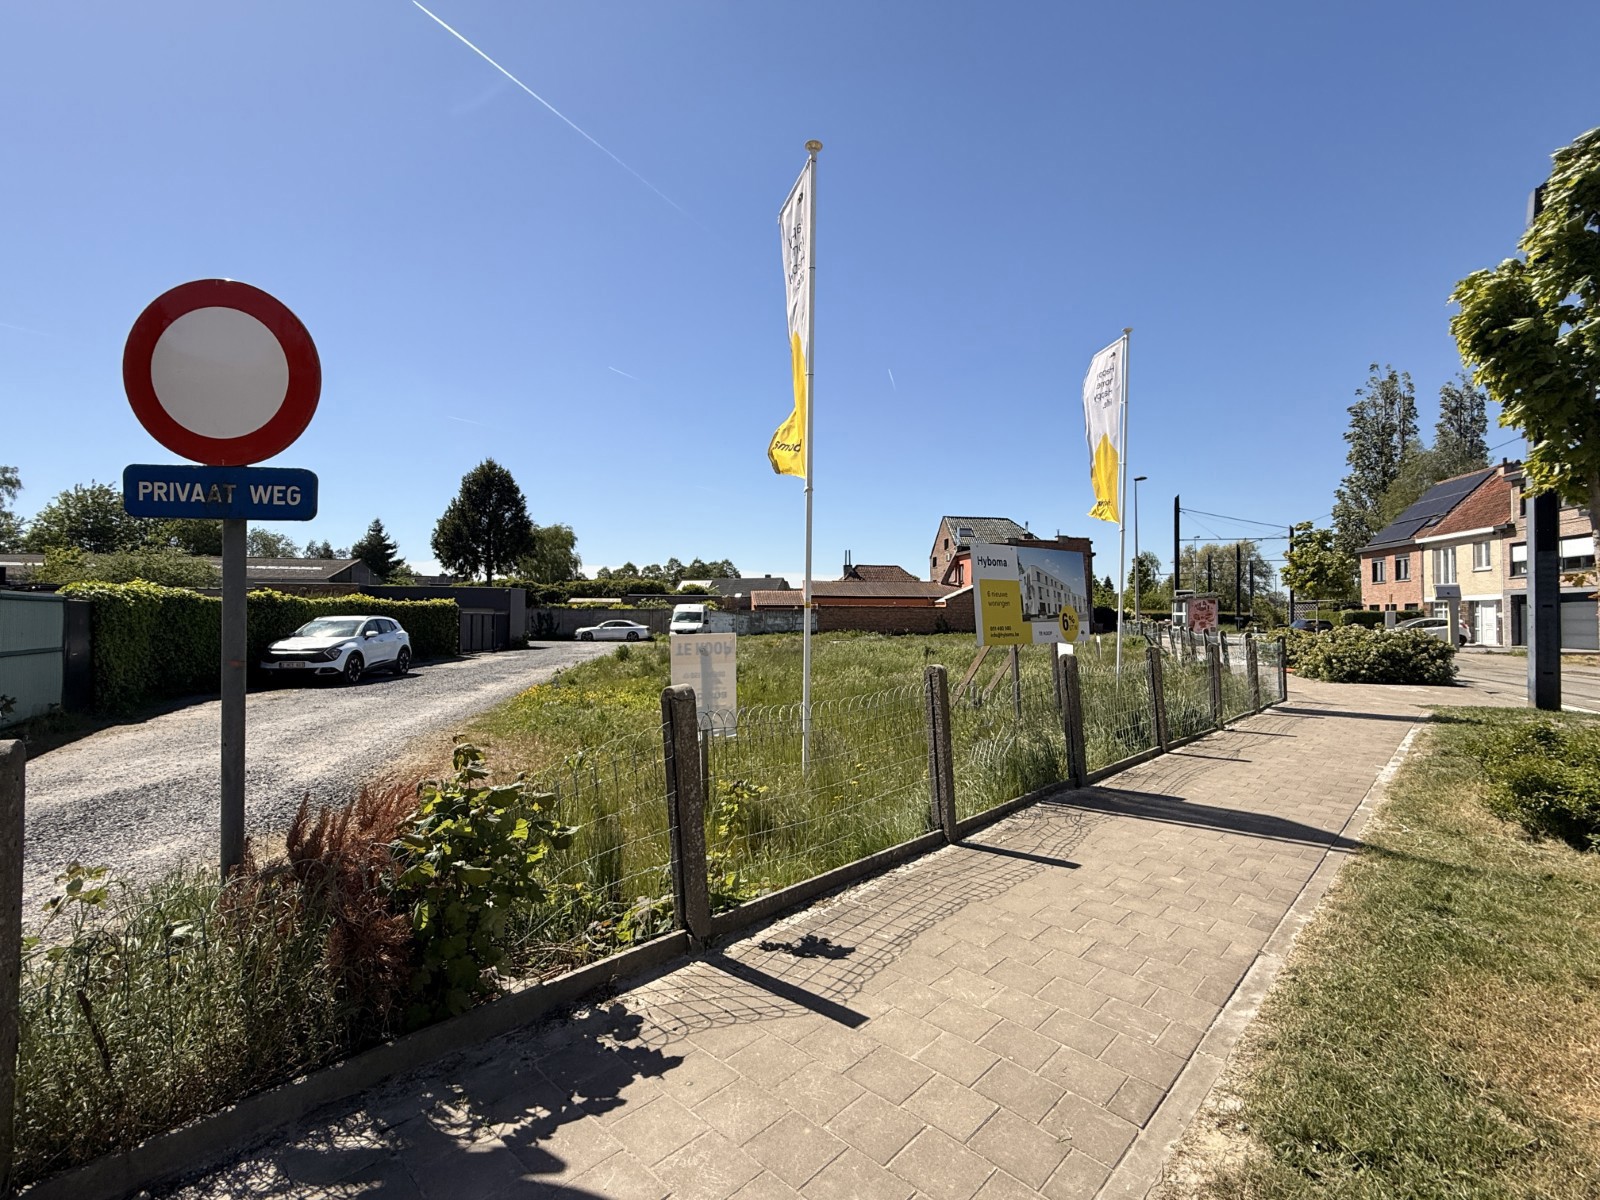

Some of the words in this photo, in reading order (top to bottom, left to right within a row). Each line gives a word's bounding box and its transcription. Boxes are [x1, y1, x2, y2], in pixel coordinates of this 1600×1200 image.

[138, 481, 237, 504] PRIVAAT
[250, 485, 301, 505] WEG
[977, 556, 1008, 568] Hyboma
[988, 600, 1011, 608] woningen
